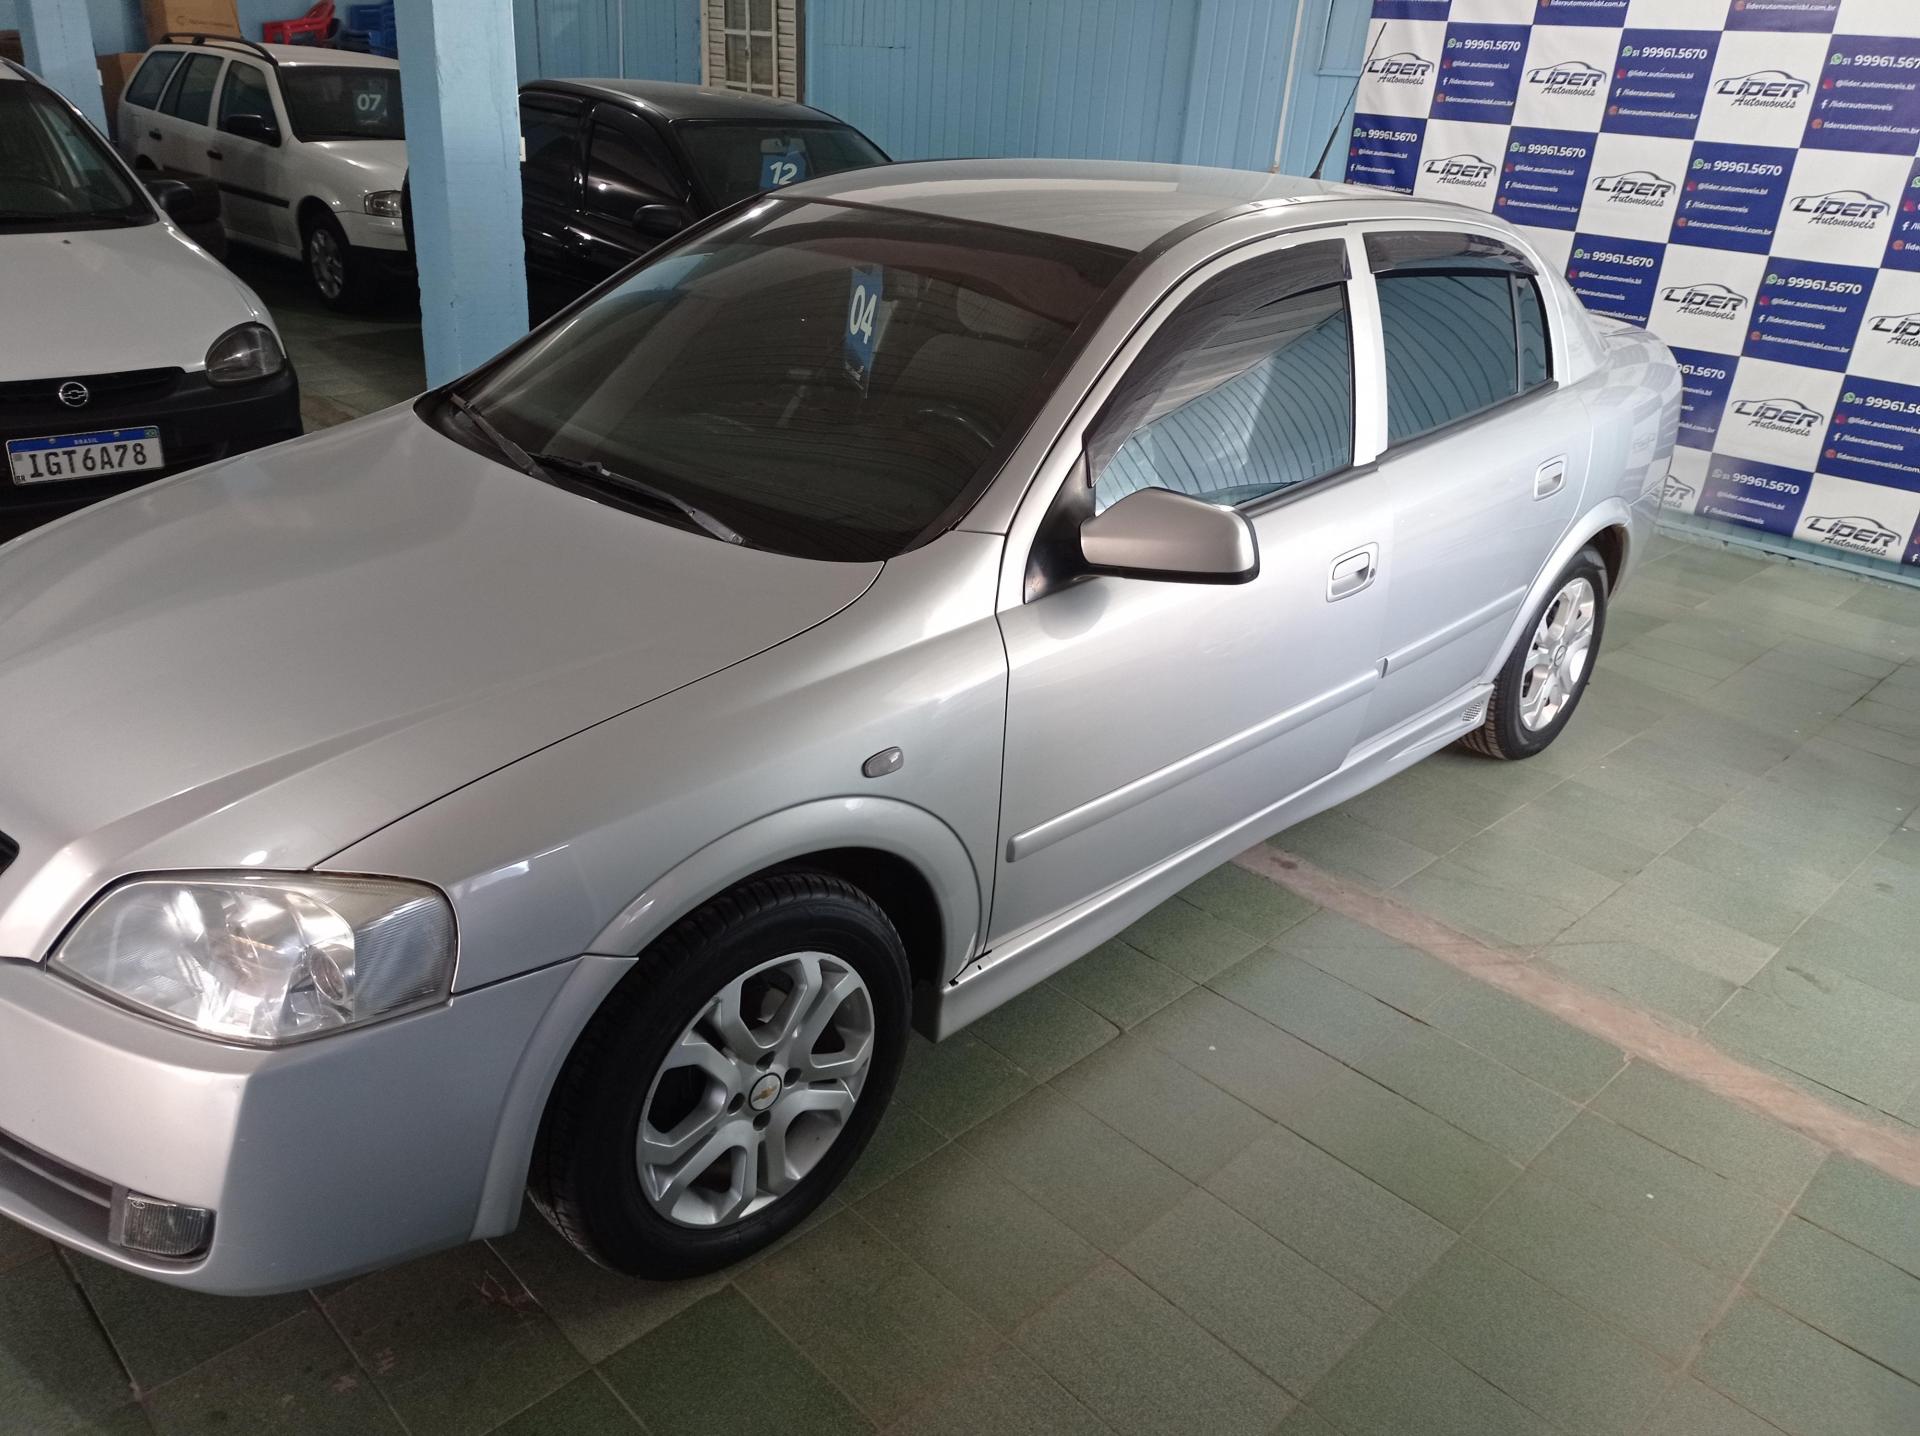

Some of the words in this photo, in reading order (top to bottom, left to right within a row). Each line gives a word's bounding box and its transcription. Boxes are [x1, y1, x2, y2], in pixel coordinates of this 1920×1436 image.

[1464, 39, 1521, 52] 99961.5670
[1641, 46, 1708, 60] 99961.5670
[1841, 57, 1851, 66] 51
[357, 93, 381, 111] 07
[1368, 128, 1418, 143] 99961.5670
[1527, 143, 1587, 159] 99961.5670
[769, 161, 798, 186] 12
[1713, 160, 1783, 176] 99961.5670
[1592, 250, 1654, 268] 99961.5670
[1787, 276, 1862, 295] 99961.5670
[850, 284, 877, 345] 04
[73, 438, 99, 446] BRASIL
[29, 442, 148, 478] IGT6A78
[1731, 472, 1800, 495] 99961.5670
